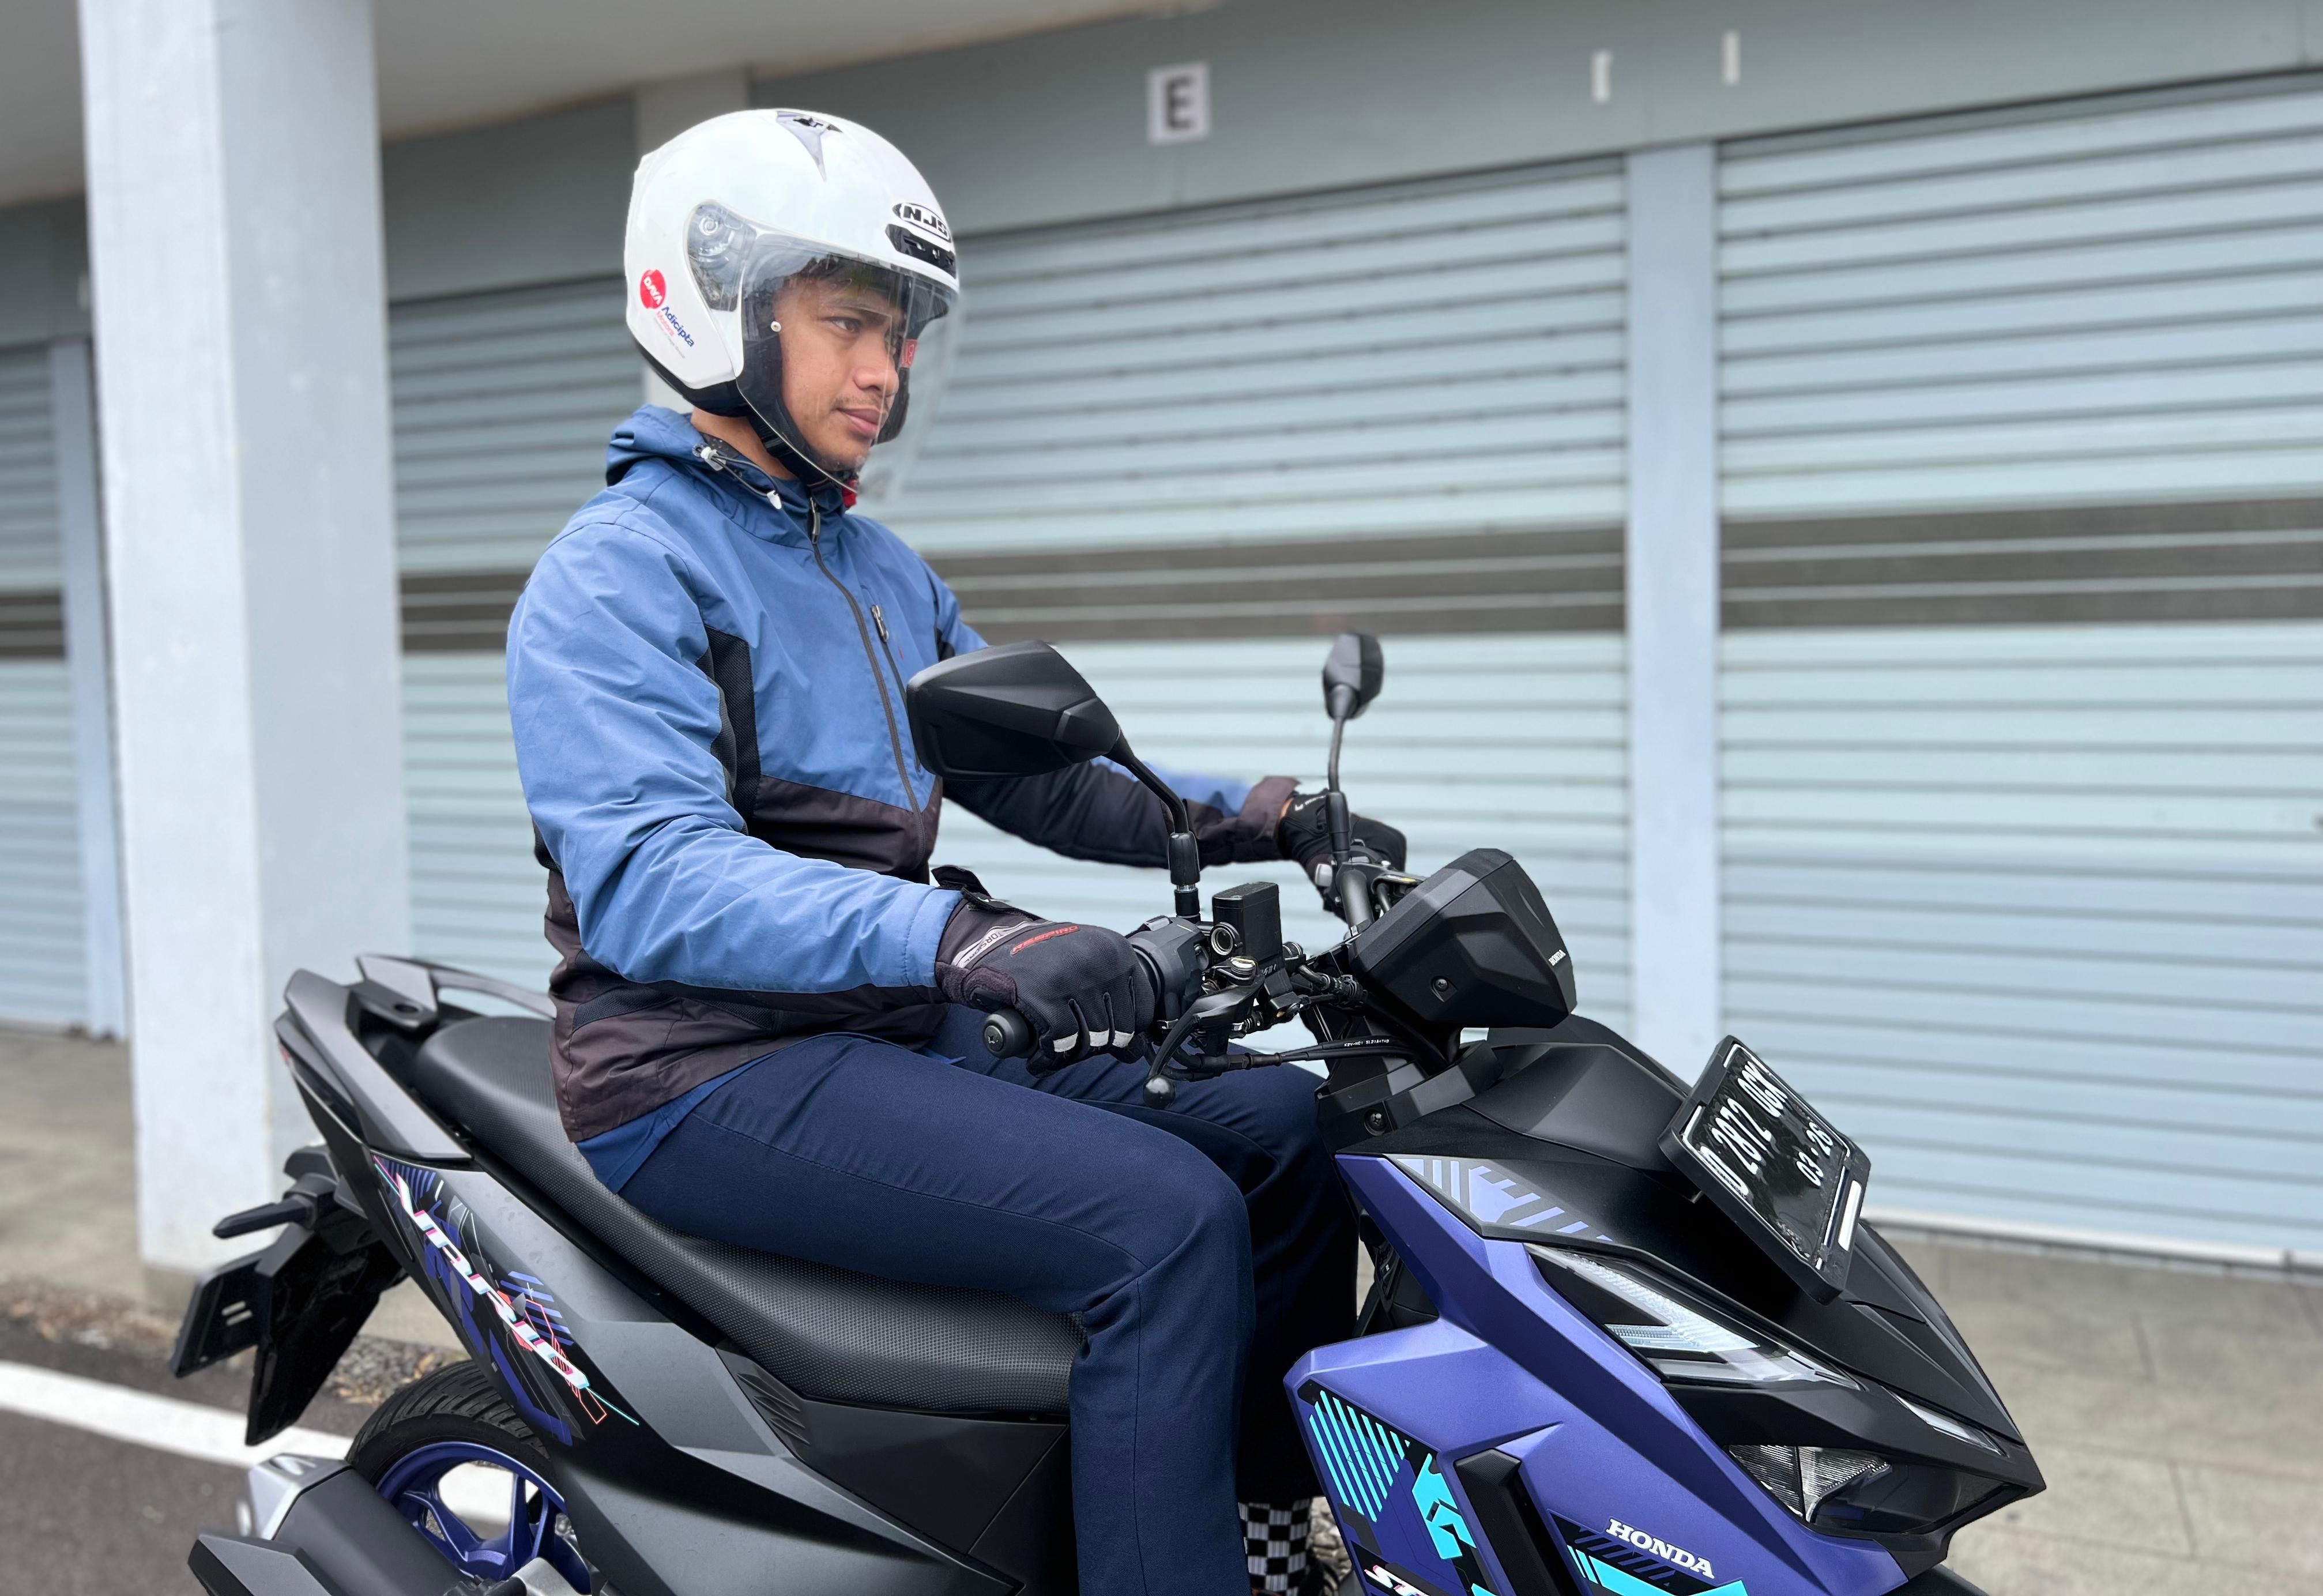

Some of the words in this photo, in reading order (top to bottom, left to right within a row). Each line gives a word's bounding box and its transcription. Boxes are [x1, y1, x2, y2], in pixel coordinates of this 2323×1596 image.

[1165, 75, 1196, 129] E
[902, 205, 948, 238] NJS
[661, 306, 694, 347] Adicipta
[1548, 949, 1566, 966] HONDA
[1711, 1098, 1772, 1175] 2872
[396, 1172, 590, 1390] VARIO
[1606, 1518, 1715, 1579] HONDA
